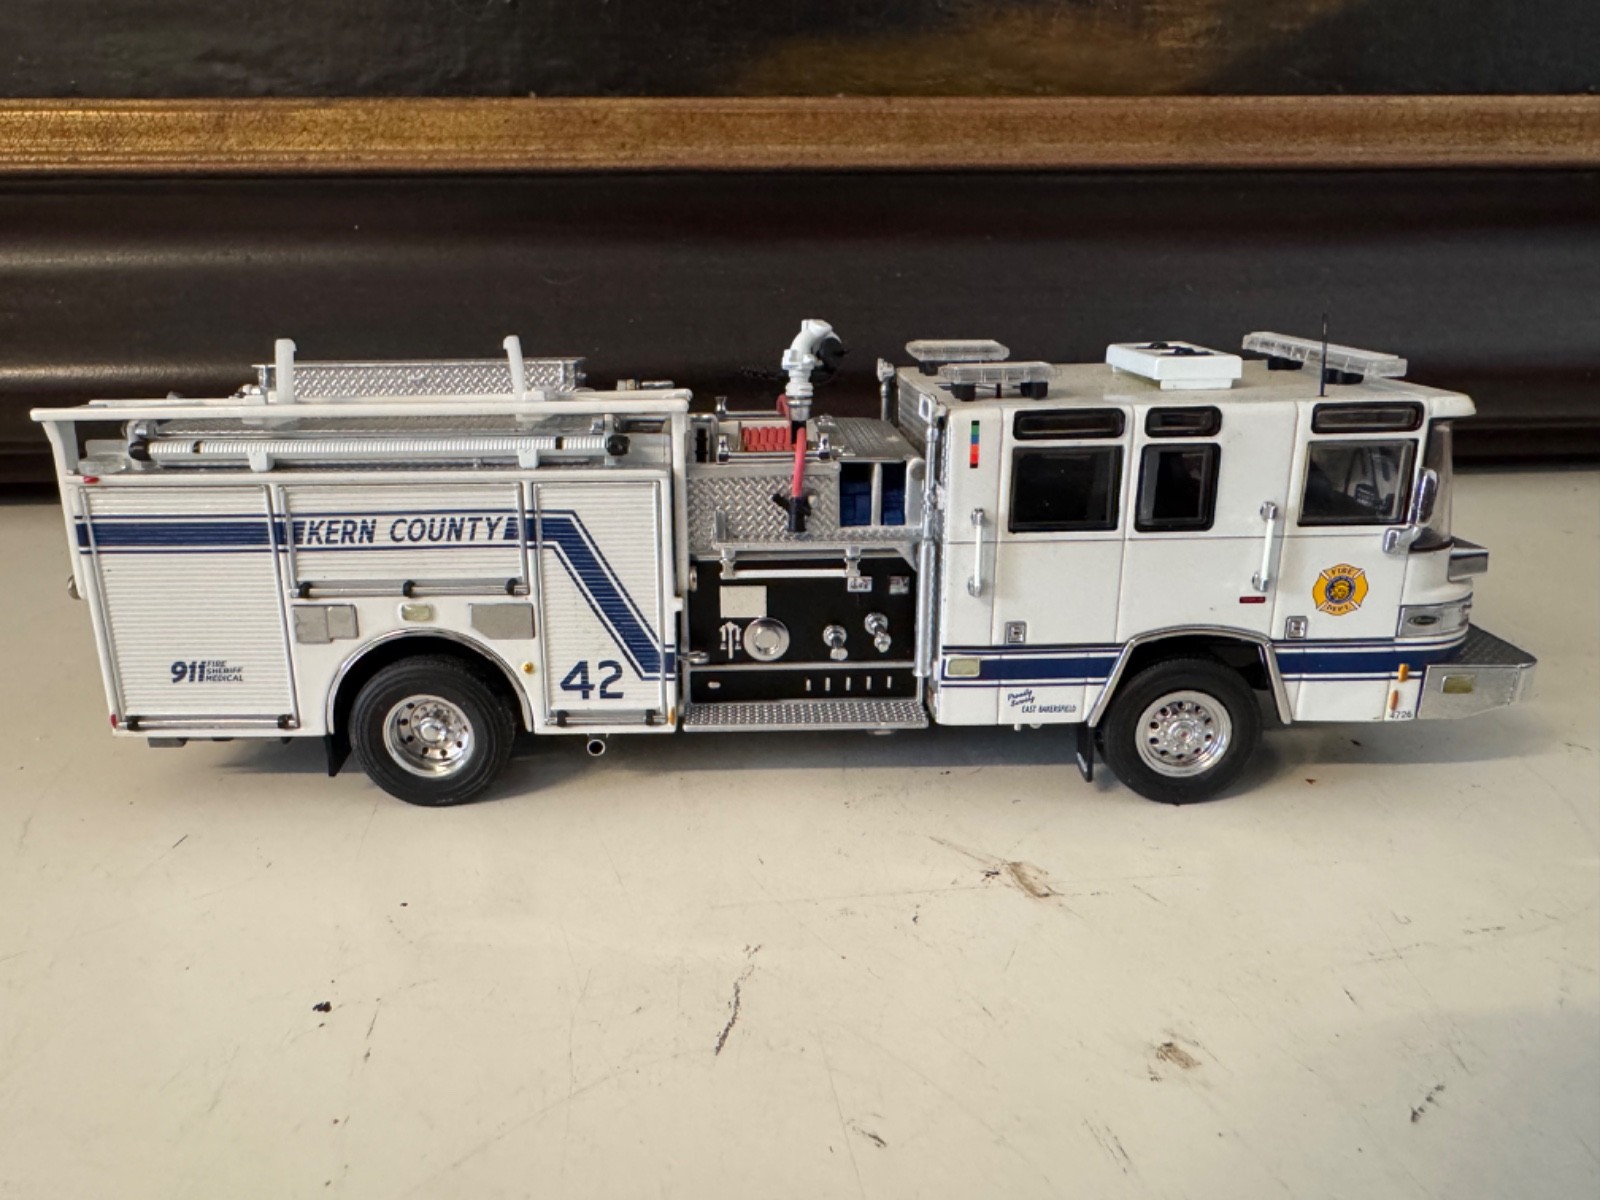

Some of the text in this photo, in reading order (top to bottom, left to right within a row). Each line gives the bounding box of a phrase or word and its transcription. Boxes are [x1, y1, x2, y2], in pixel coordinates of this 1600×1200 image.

[306, 516, 503, 545] KERN COUNTY
[1331, 567, 1352, 576] FIRE
[170, 661, 206, 684] 911
[205, 666, 244, 674] SHERIFF
[205, 674, 244, 682] MEDICAL
[559, 659, 625, 700] 42
[1021, 704, 1077, 714] EAST BAKERSFIELD
